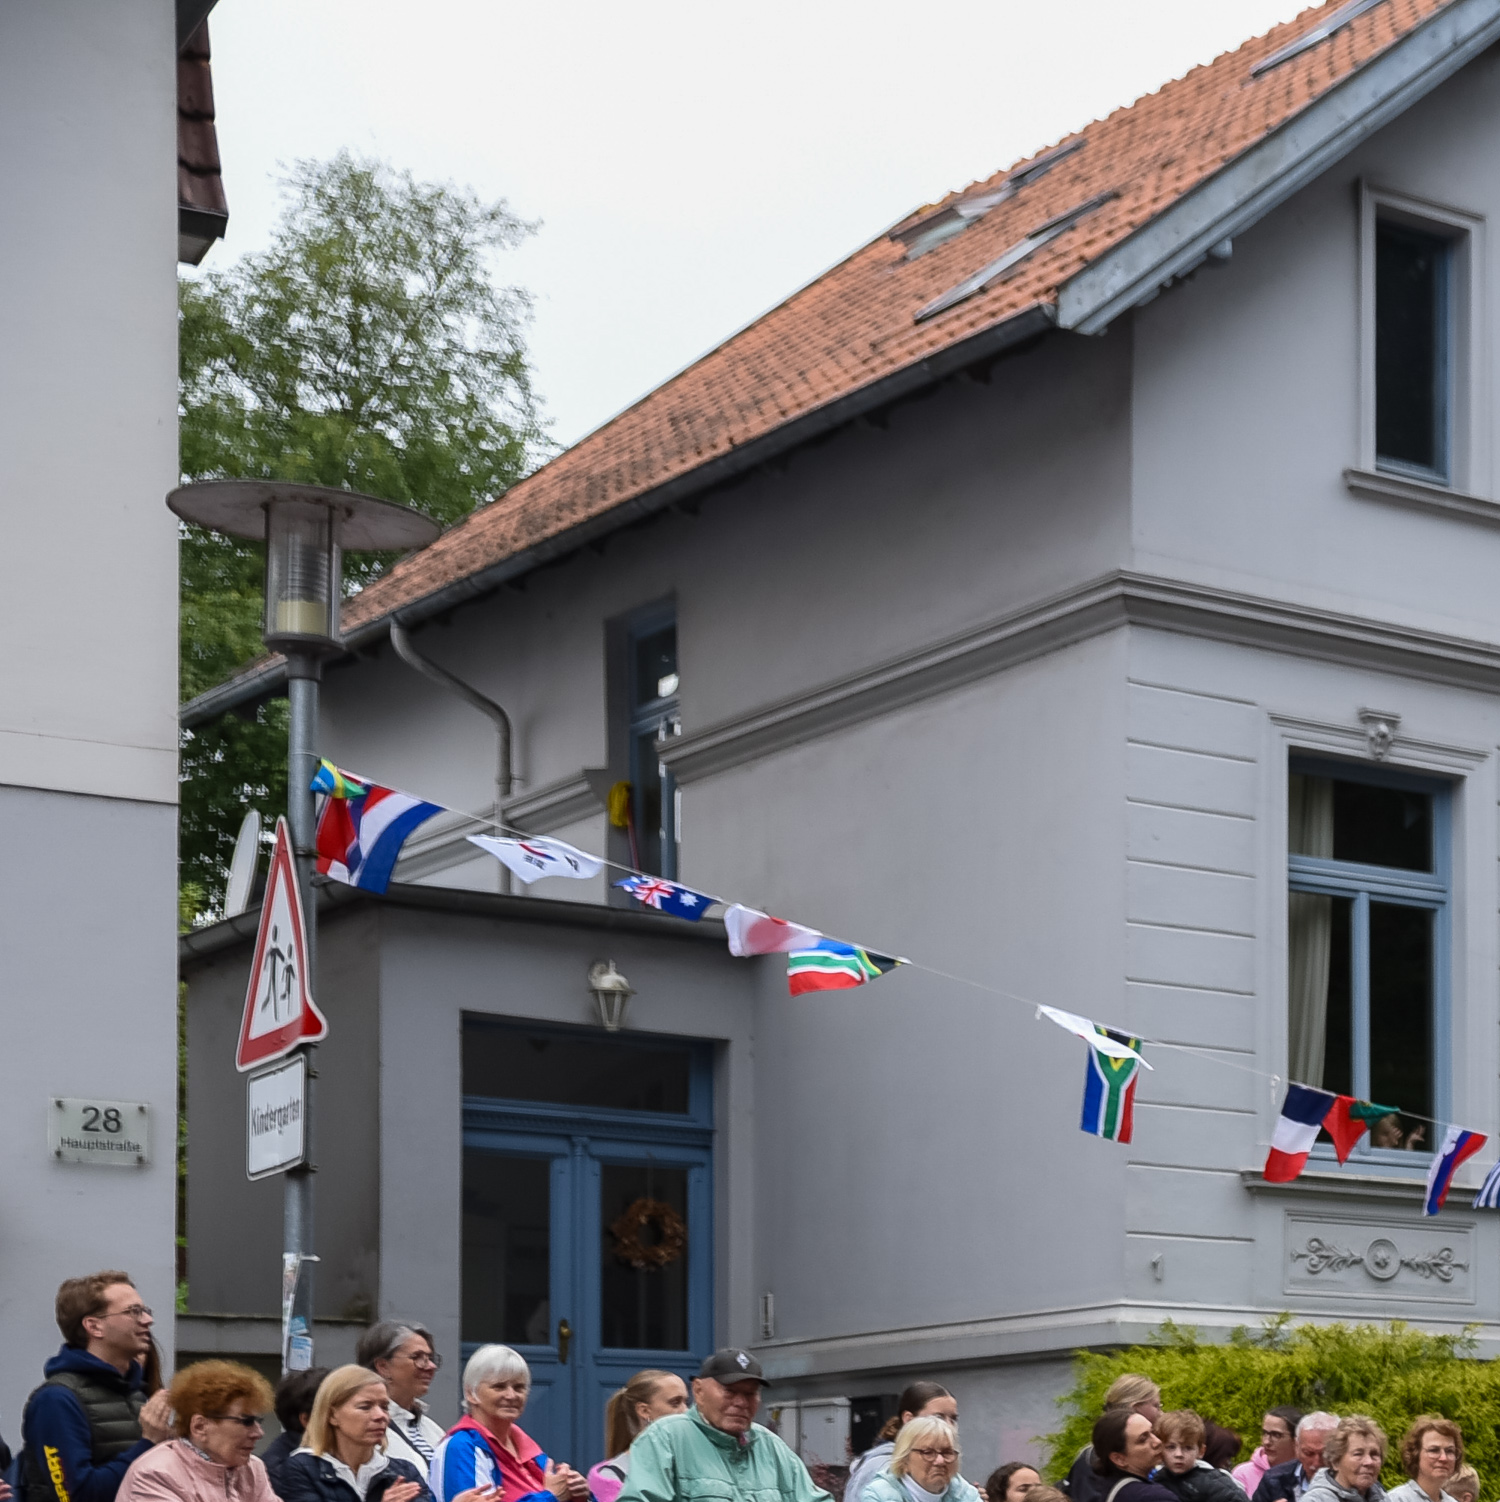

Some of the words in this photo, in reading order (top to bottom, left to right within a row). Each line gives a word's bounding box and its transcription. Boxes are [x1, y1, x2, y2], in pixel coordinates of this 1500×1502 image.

[82, 1107, 122, 1133] 28
[251, 1098, 300, 1137] Kindergarten
[61, 1136, 142, 1152] Hauptstraße
